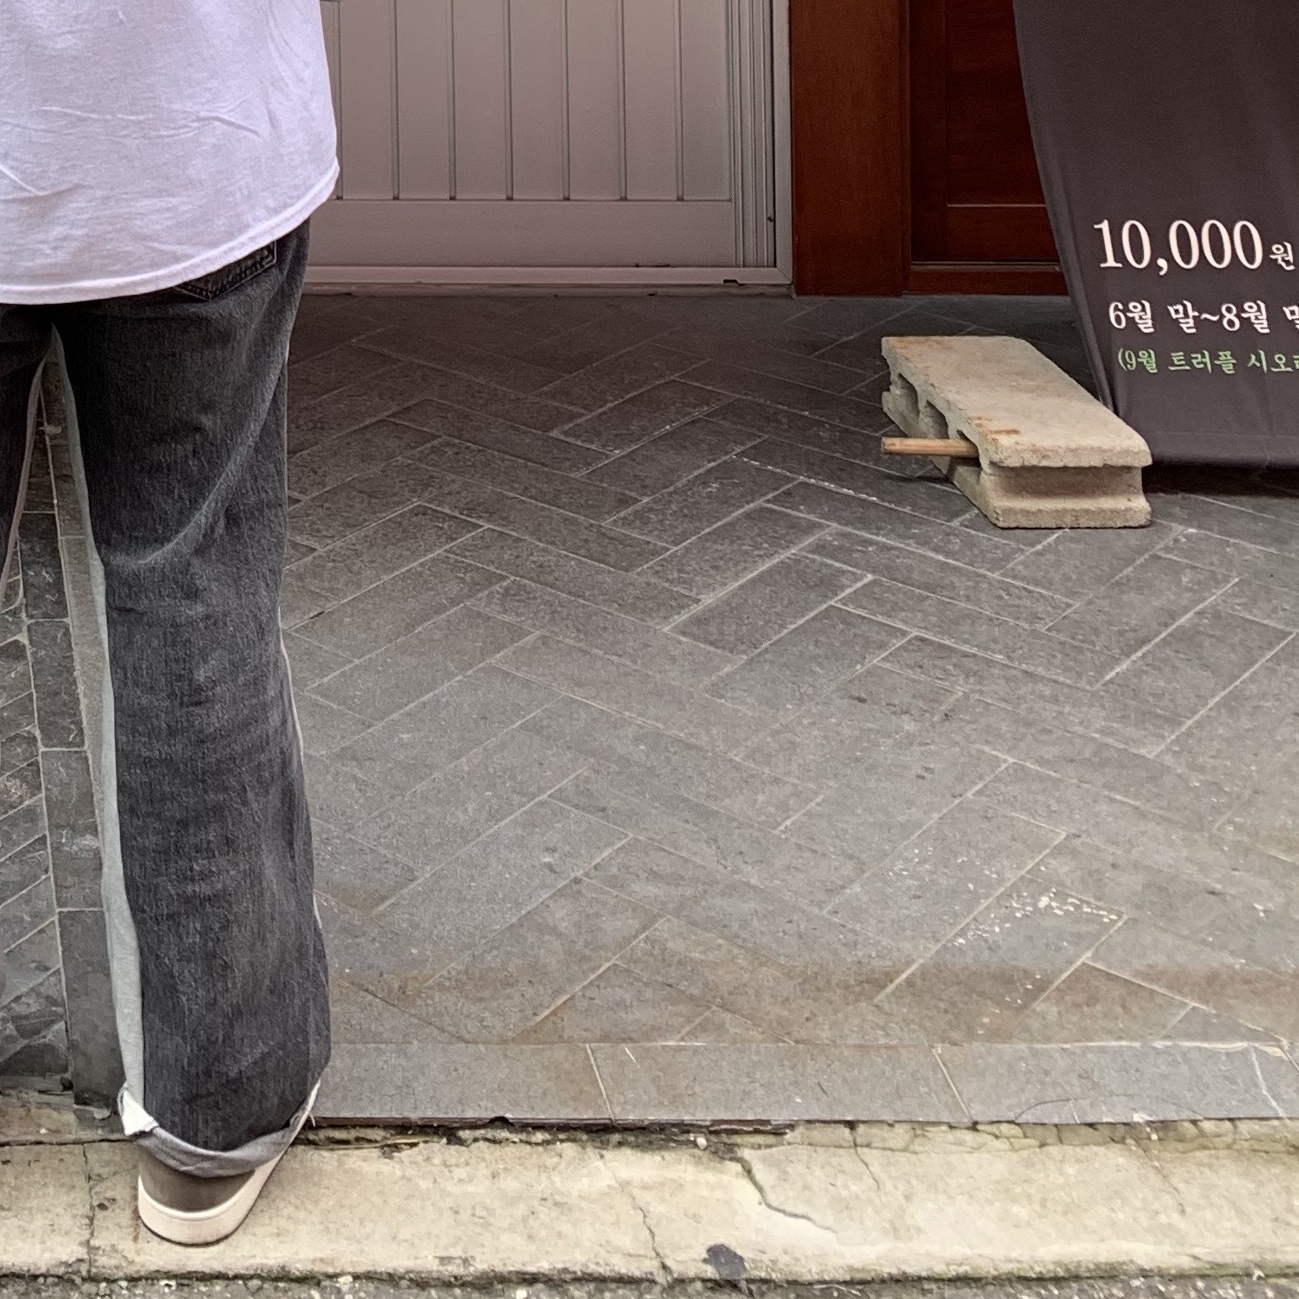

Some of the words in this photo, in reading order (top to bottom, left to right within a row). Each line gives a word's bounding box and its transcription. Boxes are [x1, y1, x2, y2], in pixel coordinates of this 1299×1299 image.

[1108, 300, 1156, 334] 6월
[1167, 300, 1271, 334] 말~8월
[1117, 348, 1159, 375] (9월
[1168, 349, 1237, 375] 트러플
